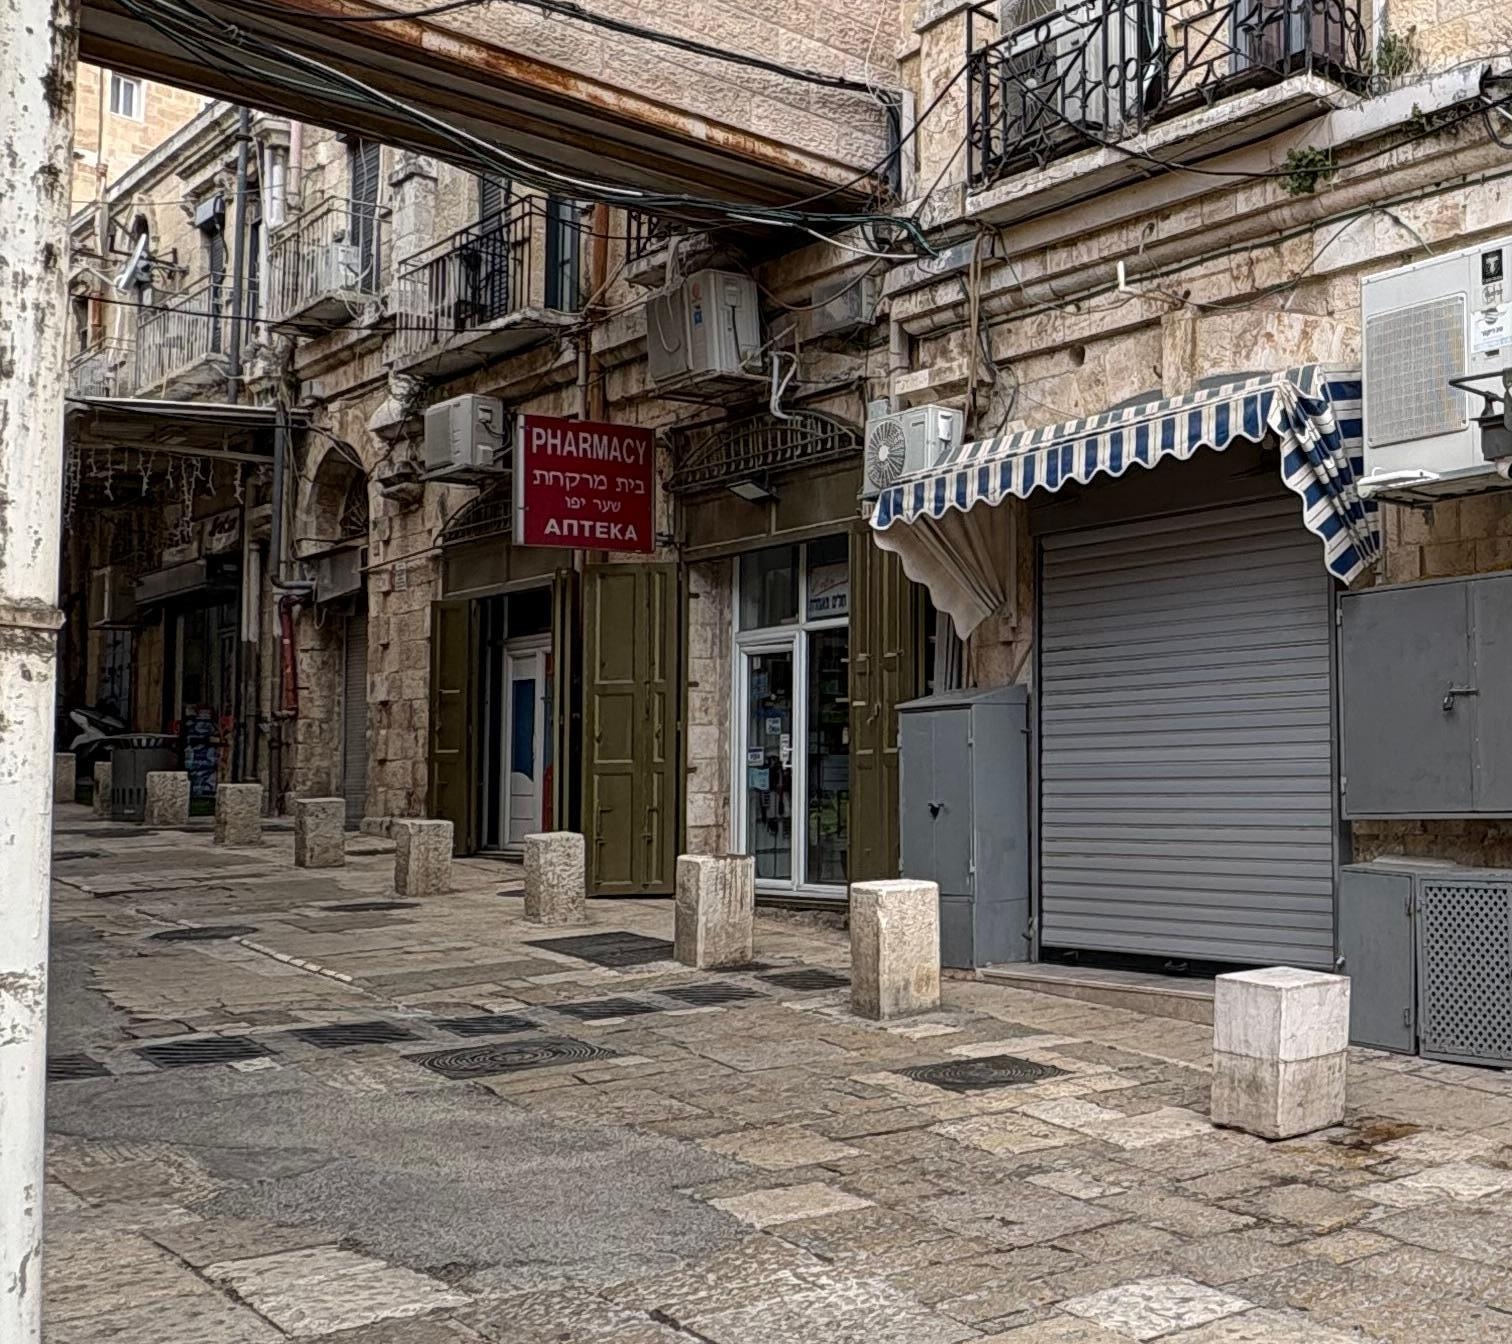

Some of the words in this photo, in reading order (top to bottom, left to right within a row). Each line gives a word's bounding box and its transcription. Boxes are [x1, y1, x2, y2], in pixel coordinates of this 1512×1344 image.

[531, 427, 647, 465] PHARMACY
[533, 469, 607, 492] מרקחת
[615, 477, 645, 494] בית
[565, 496, 587, 509] יפו
[593, 499, 621, 513] שער
[543, 518, 638, 541] АПТЕКА
